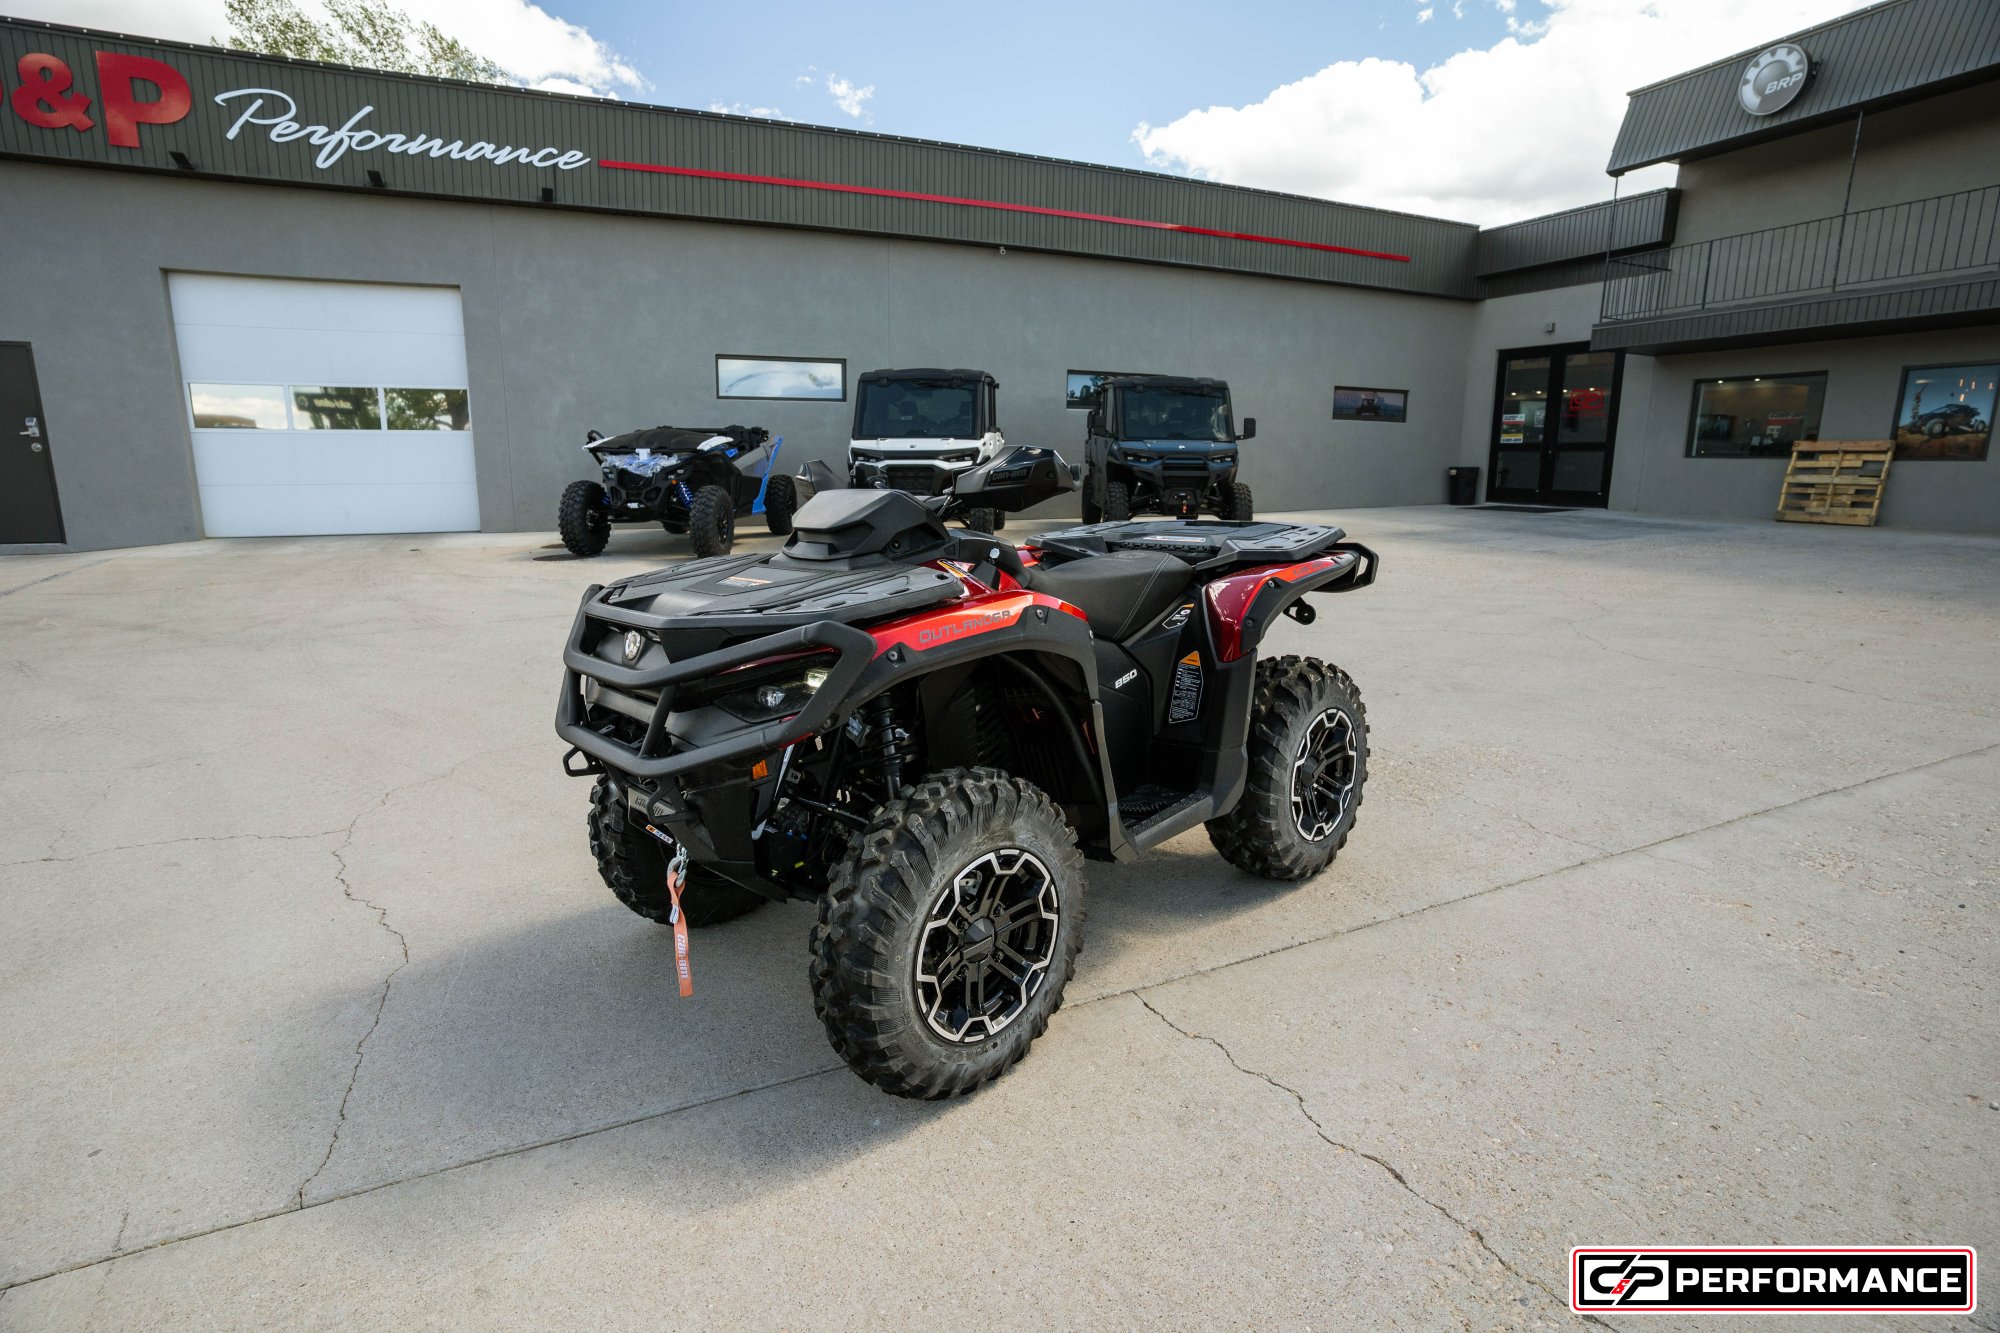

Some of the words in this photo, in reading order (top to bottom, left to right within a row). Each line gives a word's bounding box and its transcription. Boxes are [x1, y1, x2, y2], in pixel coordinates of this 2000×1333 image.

[1764, 72, 1804, 95] BRP
[0, 51, 192, 148] &P
[214, 88, 591, 170] Performance
[918, 609, 1012, 644] OUTLANDER
[1114, 668, 1138, 689] 850
